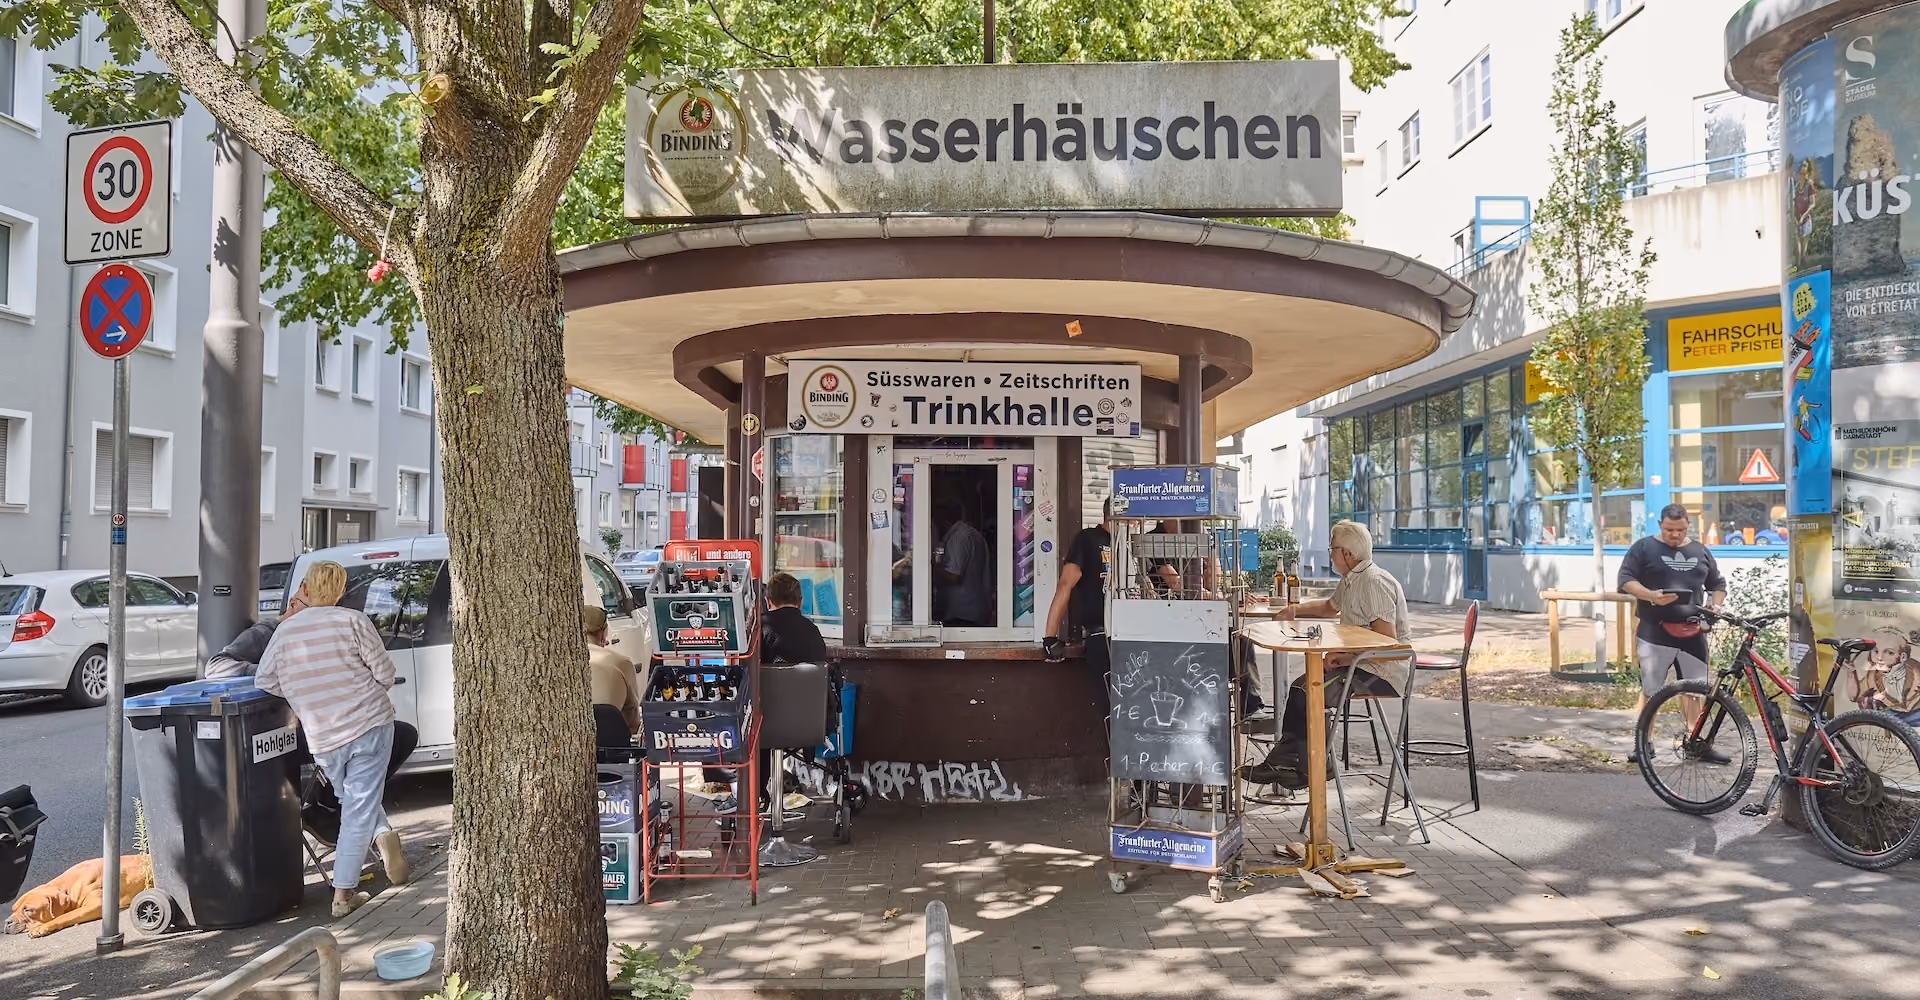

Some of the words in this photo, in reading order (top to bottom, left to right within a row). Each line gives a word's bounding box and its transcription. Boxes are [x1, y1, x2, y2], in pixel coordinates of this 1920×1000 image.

[1845, 83, 1876, 97] STÄDEL
[1845, 90, 1876, 104] MUSEUM
[767, 100, 1321, 165] Wasserhäuschen
[661, 133, 732, 153] BINDING
[97, 159, 137, 201] 30
[90, 228, 143, 253] ZONE
[1846, 288, 1862, 302] DIE
[1845, 304, 1867, 318] VON
[1871, 297, 1918, 315] ÉTRETAT
[1683, 343, 1727, 357] PETER
[867, 371, 976, 387] Süsswaren
[1000, 373, 1129, 390] Zeitschriften
[809, 391, 849, 403] BINDING
[903, 395, 1094, 427] Trinkhalle
[1843, 425, 1897, 434] MATHILDENHÖHE
[1843, 432, 1881, 440] DARMSTADT
[1119, 483, 1161, 497] Frankfurter
[1162, 482, 1205, 497] Allgemeine
[706, 549, 721, 559] und
[723, 549, 751, 560] andere
[256, 732, 295, 756] Hohlglas
[1118, 835, 1161, 849] Frankfurter
[1162, 837, 1206, 853] Allgemeine
